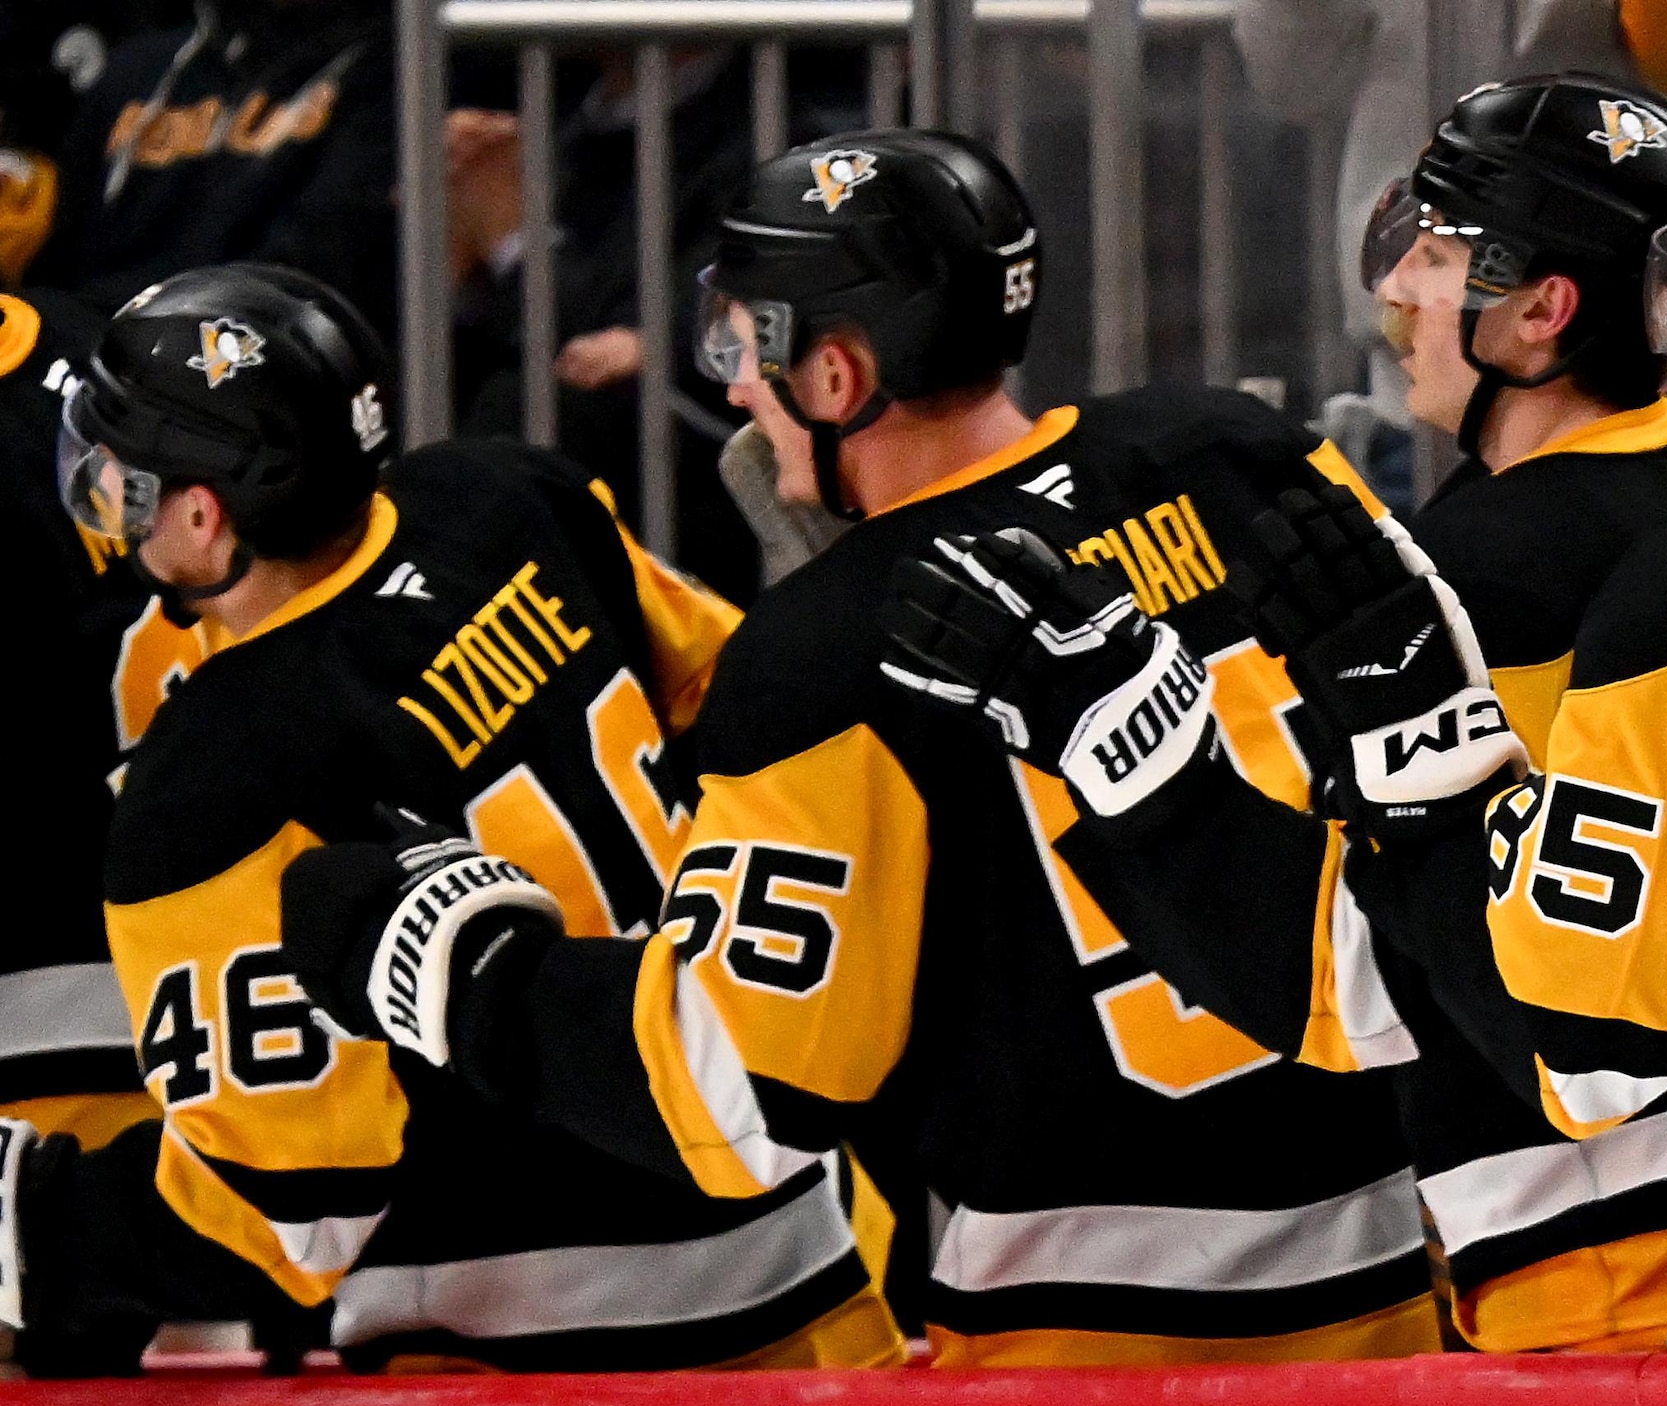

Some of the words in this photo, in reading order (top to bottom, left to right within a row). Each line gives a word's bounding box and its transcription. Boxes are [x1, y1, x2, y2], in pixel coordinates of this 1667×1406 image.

[1003, 259, 1034, 314] 55
[1065, 494, 1227, 618] IARI
[396, 560, 593, 771] LIZOTTE
[660, 838, 855, 999] 55
[139, 942, 340, 1108] 46
